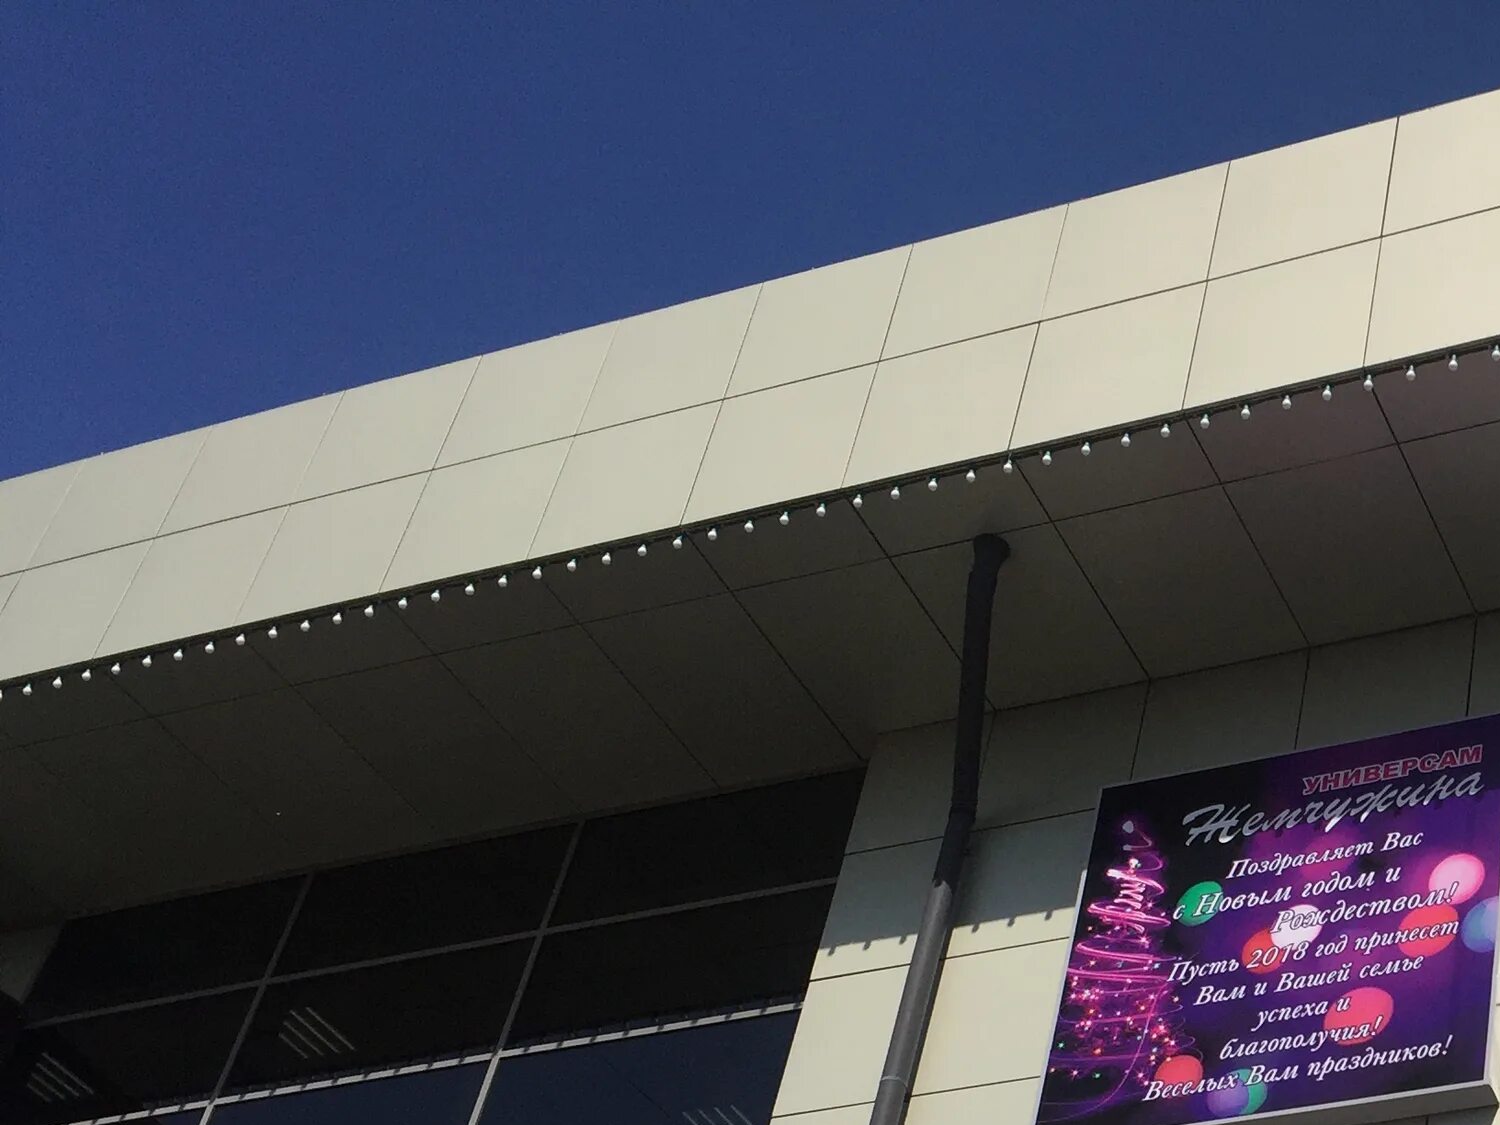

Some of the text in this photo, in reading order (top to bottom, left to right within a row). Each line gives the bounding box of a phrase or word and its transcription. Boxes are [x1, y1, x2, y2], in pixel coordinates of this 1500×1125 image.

[1302, 745, 1483, 795] УНИВЕРСАМ
[1182, 772, 1485, 846] Жемчужина
[1225, 831, 1424, 880] Поздравляет Вас
[1172, 866, 1401, 920] с Новым годом и
[1269, 882, 1460, 934] Рождеством!
[1167, 920, 1460, 984] Пусть 2018 год принесет
[1193, 955, 1424, 1007] Вам и Вашей семье
[1218, 1016, 1384, 1061] благополучия!
[1251, 995, 1351, 1032] успеха и
[1143, 1034, 1453, 1102] Веселых Вам праздников!
